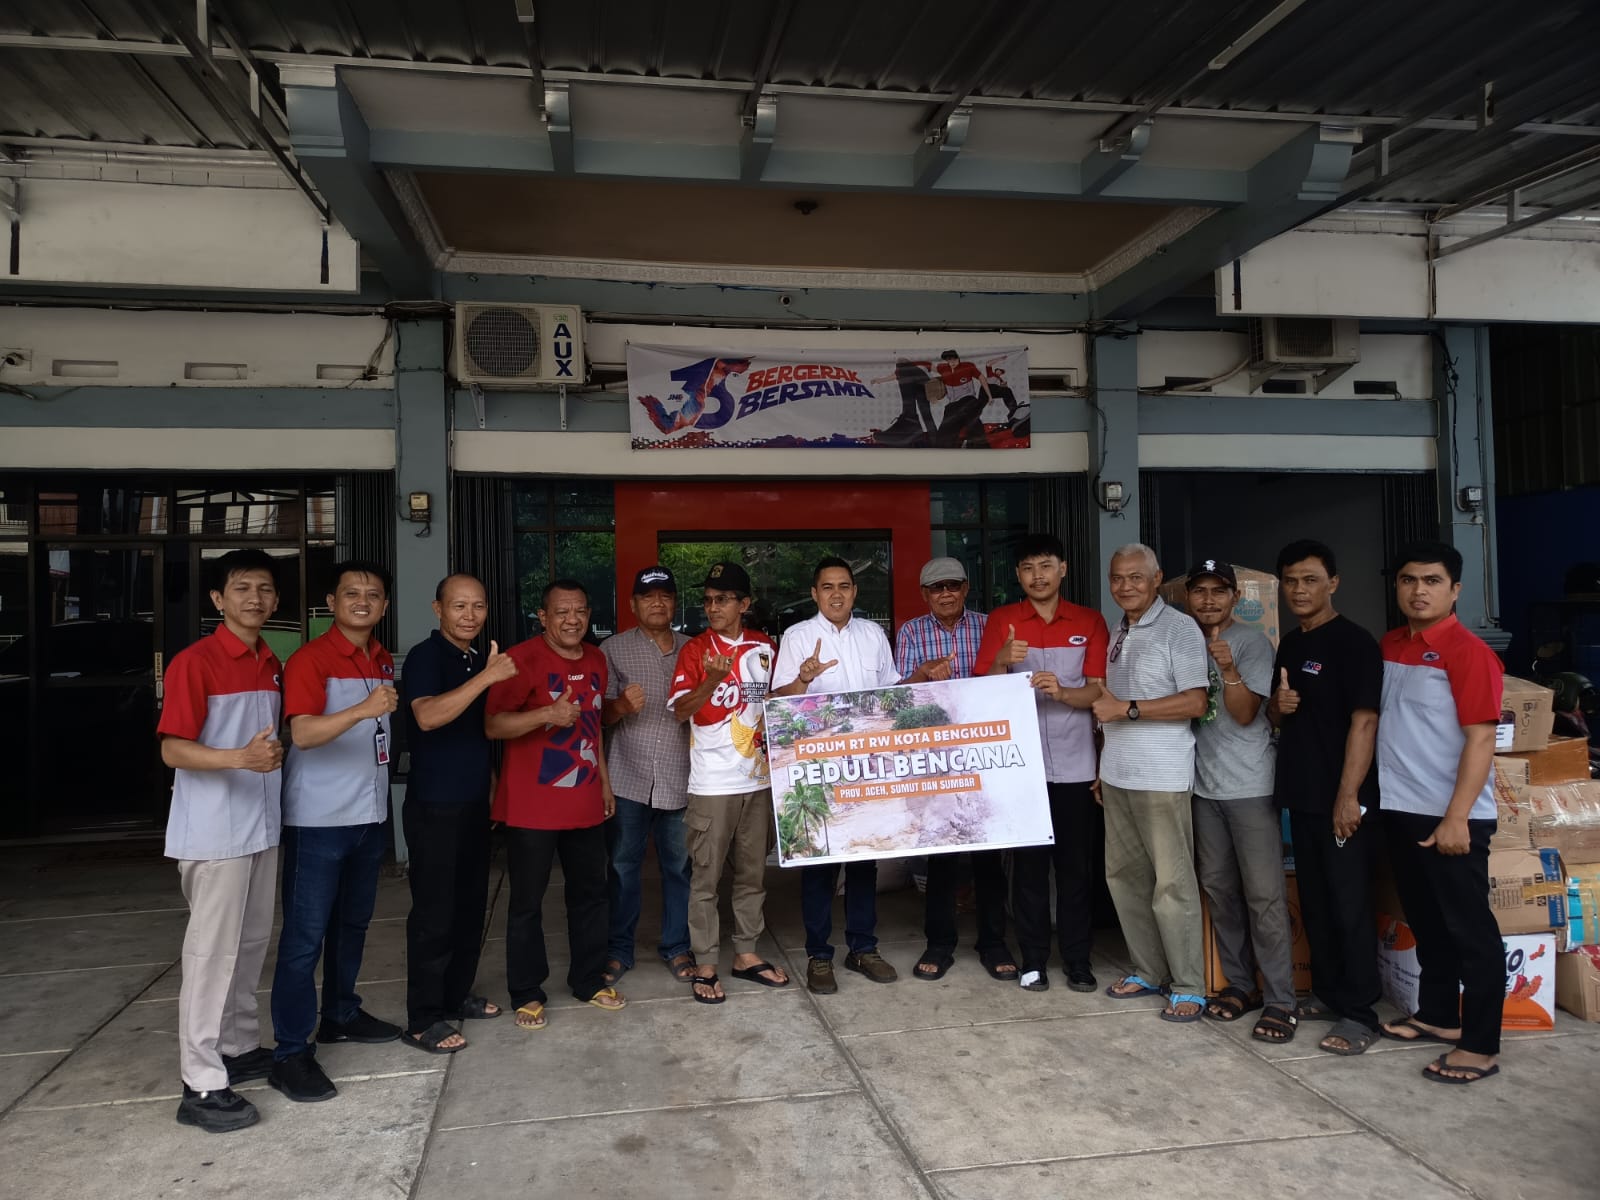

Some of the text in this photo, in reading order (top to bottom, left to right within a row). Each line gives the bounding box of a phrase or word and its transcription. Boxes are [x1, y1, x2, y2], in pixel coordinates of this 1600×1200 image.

[553, 323, 573, 376] AUX
[746, 364, 863, 393] BERGERAK
[735, 380, 875, 420] BERSAMA
[710, 682, 740, 709] 80
[798, 725, 1007, 755] FORUM RT RW KOTA BENGKULU
[787, 743, 1025, 787] PEDULI BENCANA
[840, 777, 975, 798] PROV. ACEH, SUMUT DAN SUMBAR
